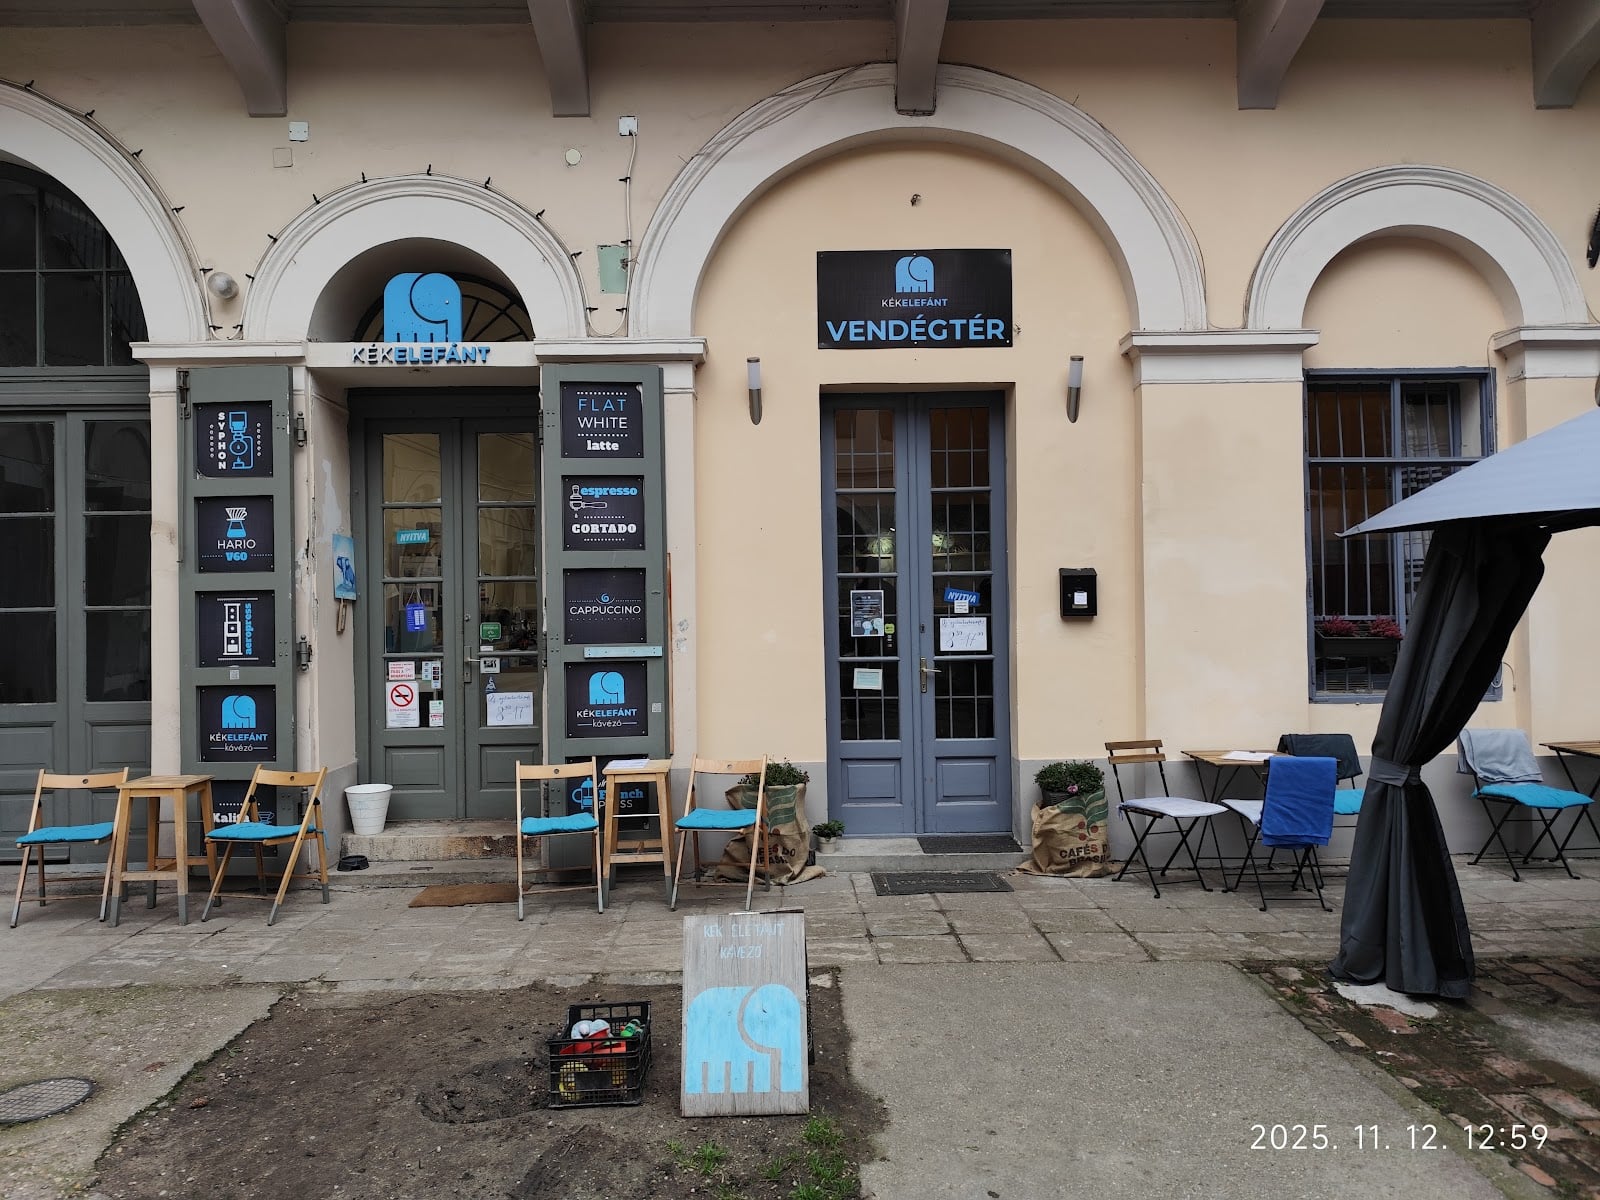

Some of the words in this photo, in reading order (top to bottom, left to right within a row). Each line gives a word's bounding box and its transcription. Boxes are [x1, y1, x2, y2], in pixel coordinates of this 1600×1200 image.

[881, 297, 948, 308] KÉKELEFÁNT
[826, 313, 1005, 341] VENDÉGTÉR
[352, 344, 491, 364] KÉKELEFÁNT
[578, 398, 627, 412] FLAT
[578, 416, 628, 429] WHITE
[217, 411, 227, 470] SYPHON
[586, 440, 619, 451] latte
[580, 485, 638, 498] espresso
[571, 523, 637, 534] CORTADO
[400, 533, 427, 542] NYITVA
[217, 539, 256, 550] HARIO
[225, 551, 248, 561] V60
[947, 591, 977, 604] NYITVA
[569, 604, 642, 616] CAPPUCCINO
[244, 602, 254, 656] aeropress
[576, 708, 637, 719] KÉKELEFÁNT
[592, 718, 622, 728] kávézó
[209, 731, 268, 742] KÉKELEFÁNT
[224, 742, 254, 753] kávézó
[598, 788, 644, 800] Fnch
[598, 800, 633, 809] PSS
[1059, 843, 1098, 859] CAFÉS
